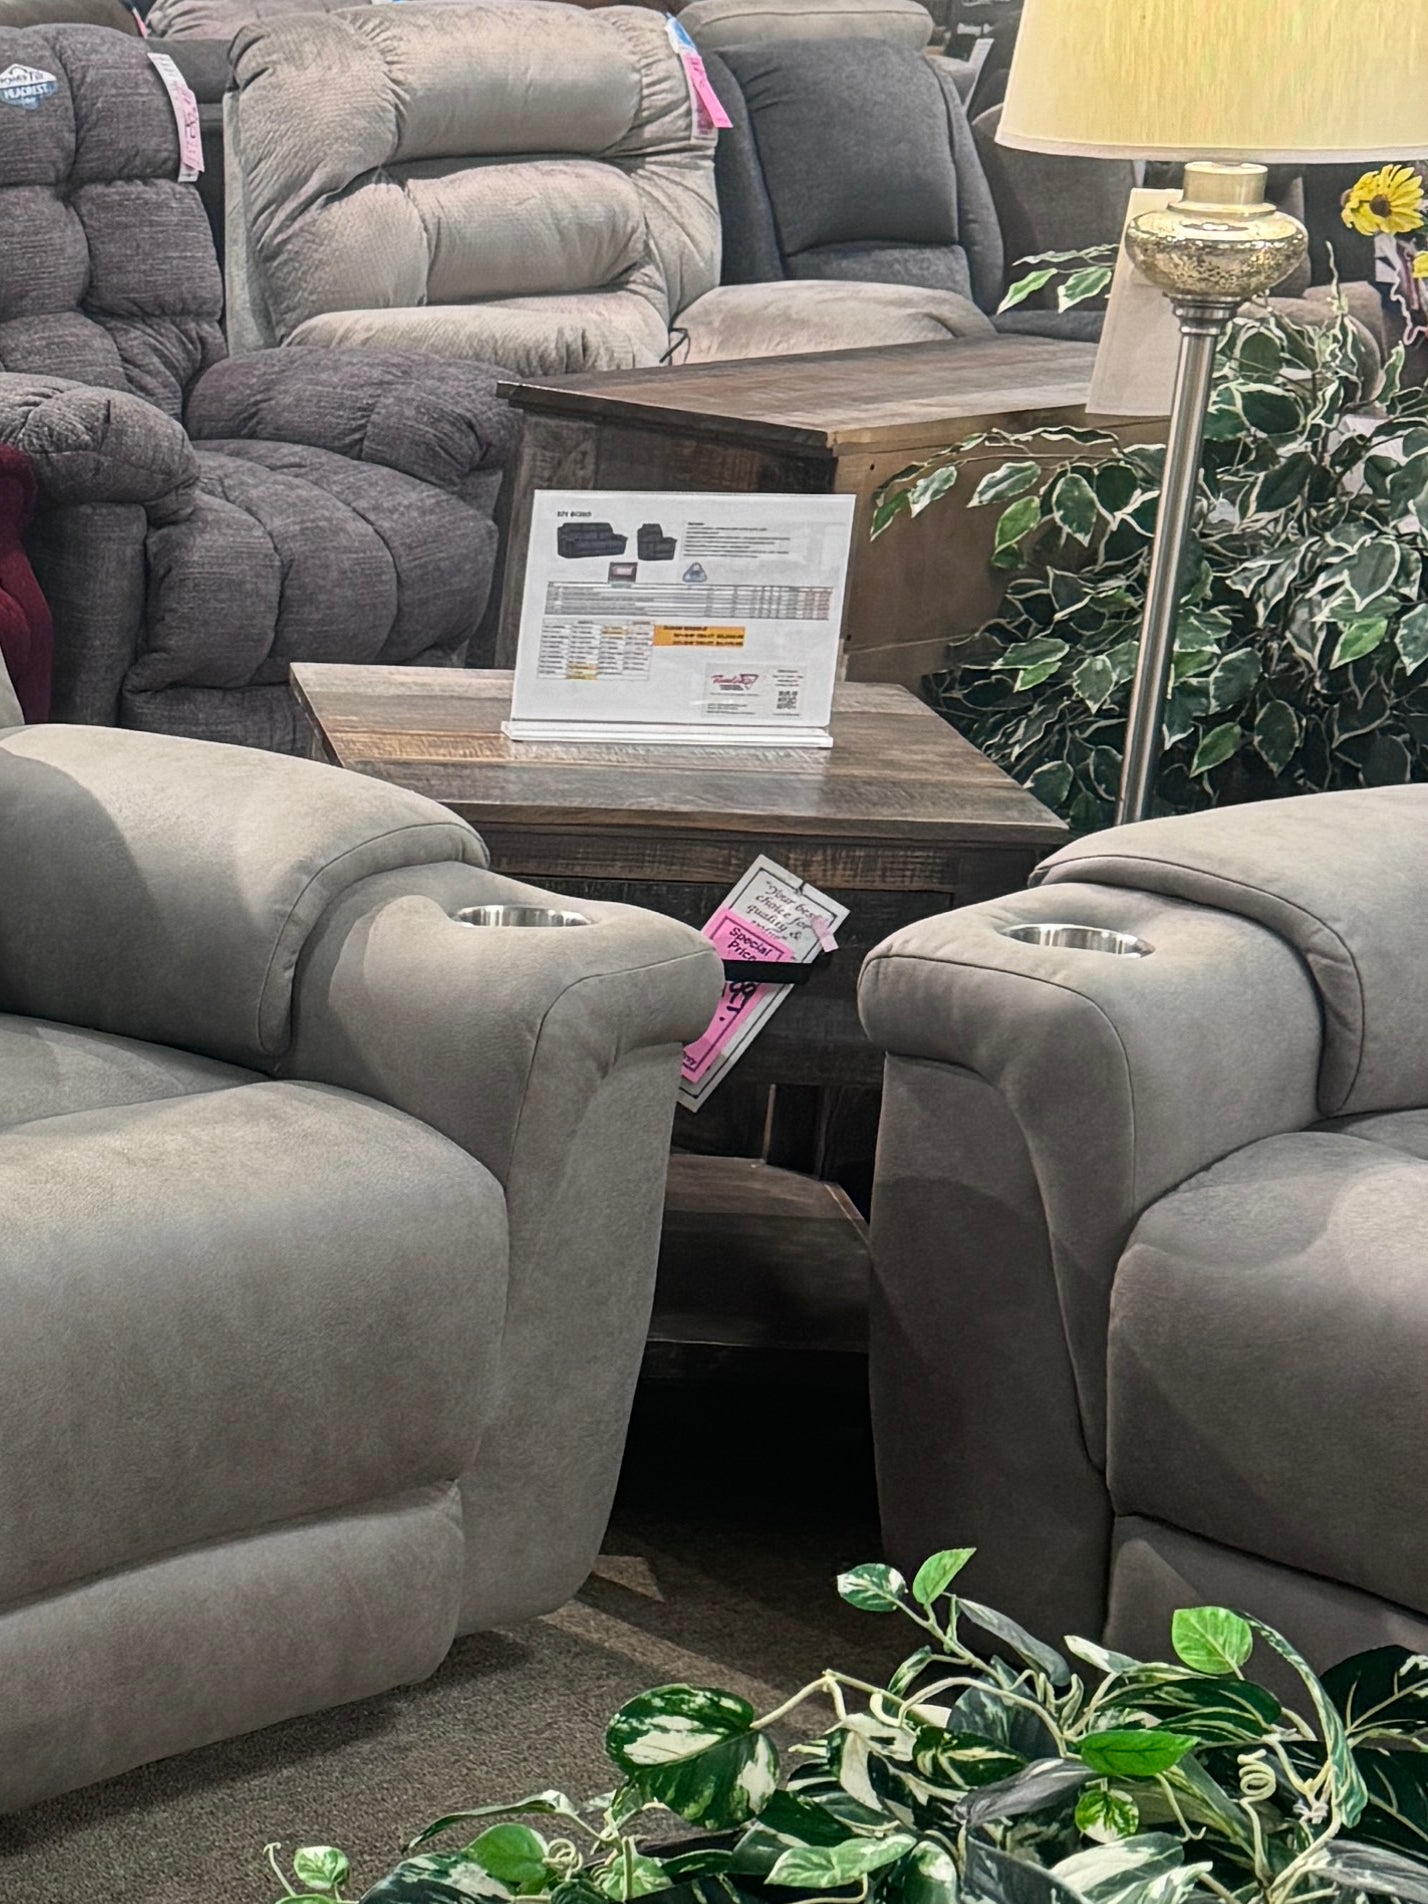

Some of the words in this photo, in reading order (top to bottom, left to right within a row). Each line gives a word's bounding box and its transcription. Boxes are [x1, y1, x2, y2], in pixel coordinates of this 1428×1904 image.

[746, 904, 789, 934] quality
[755, 894, 792, 920] choice
[790, 916, 813, 932] for
[729, 927, 773, 957] Special
